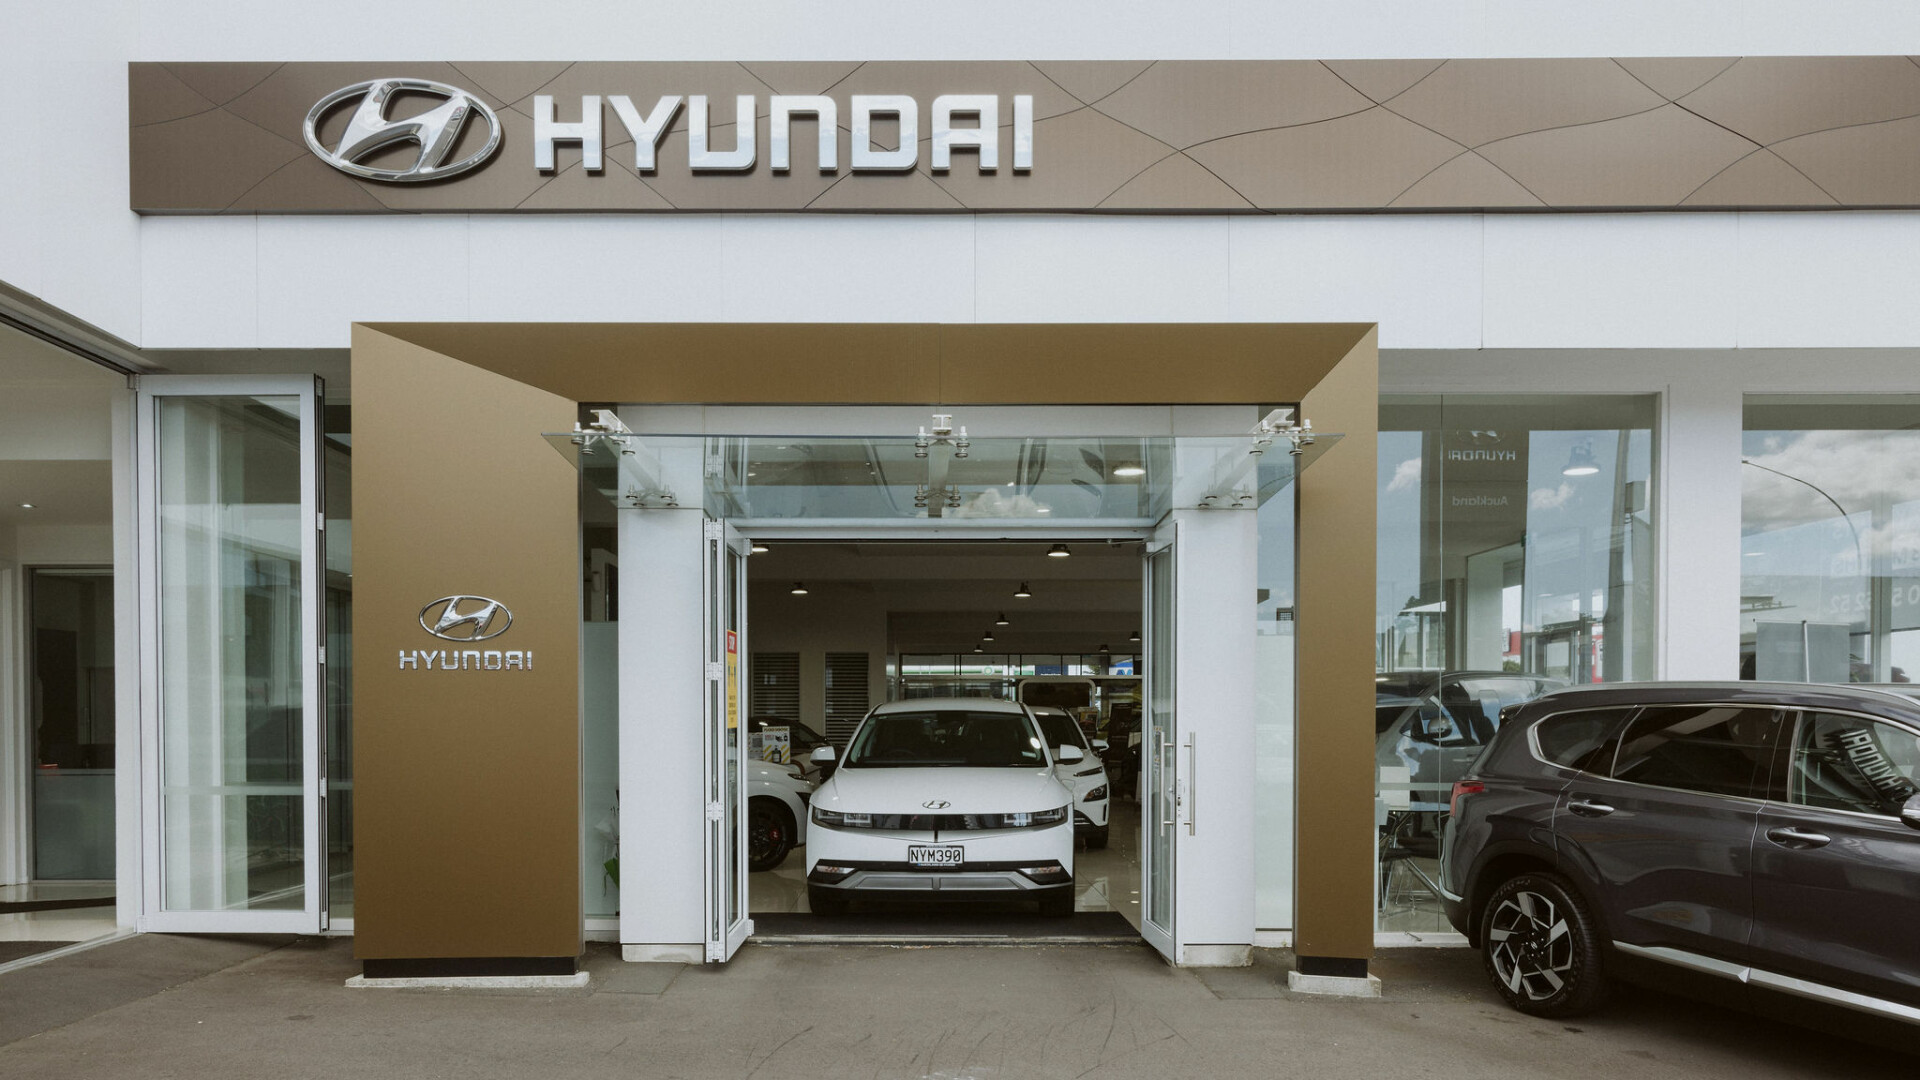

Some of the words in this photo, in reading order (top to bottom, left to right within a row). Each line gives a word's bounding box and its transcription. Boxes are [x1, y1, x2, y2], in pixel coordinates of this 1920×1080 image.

[534, 95, 1033, 171] HYUNDAI
[399, 650, 532, 670] HYUNDAI
[910, 849, 961, 862] NYM390
